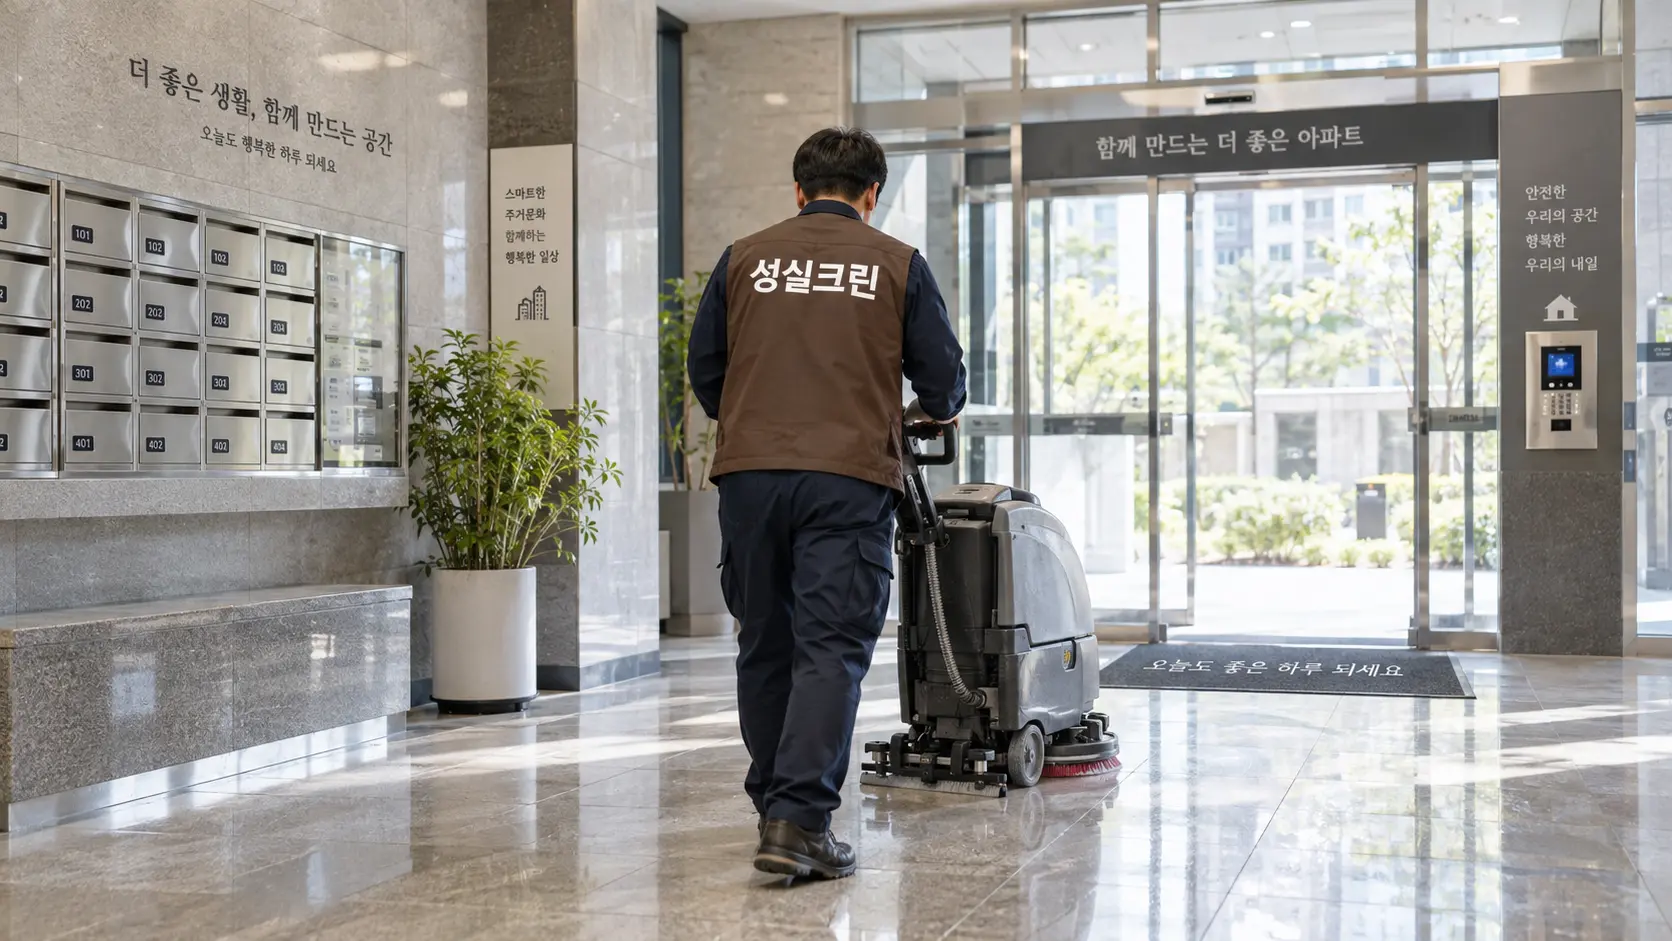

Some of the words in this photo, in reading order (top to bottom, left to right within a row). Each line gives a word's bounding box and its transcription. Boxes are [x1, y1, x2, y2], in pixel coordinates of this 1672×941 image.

[129, 58, 149, 88] 더
[159, 65, 203, 103] 좋은
[210, 82, 256, 121] 생활,
[263, 98, 299, 132] 함께
[307, 111, 356, 147] 만드는
[362, 128, 392, 157] 공간
[200, 125, 237, 148] 오늘도
[242, 135, 276, 159] 행복한
[280, 147, 302, 165] 하루
[306, 154, 337, 173] 되세요
[1096, 135, 1136, 160] 함께
[1146, 133, 1208, 157] 만드는
[1218, 130, 1237, 154] 더
[1246, 128, 1289, 154] 좋은
[1298, 125, 1364, 150] 아파트
[505, 186, 546, 200] 스마트한
[1525, 184, 1567, 201] 안전한
[505, 208, 546, 221] 주거문화
[1525, 208, 1566, 225] 우리의
[1571, 207, 1599, 223] 공간
[75, 229, 90, 240] 101
[505, 230, 546, 244] 함께하는
[148, 241, 162, 252] 102
[214, 253, 227, 263] 102
[505, 251, 536, 264] 행복한
[539, 250, 559, 264] 일상
[1525, 256, 1566, 273] 우리의
[1571, 256, 1598, 272] 내일
[750, 258, 879, 300] 성실크린
[75, 299, 91, 309] 202
[148, 308, 162, 318] 202
[75, 368, 90, 379] 301
[148, 374, 163, 384] 302
[75, 439, 91, 448] 401
[149, 440, 163, 450] 402
[1143, 659, 1214, 673] 오늘도
[1223, 660, 1268, 675] 좋은
[1278, 661, 1323, 676] 하루
[1332, 663, 1403, 677] 되세요
